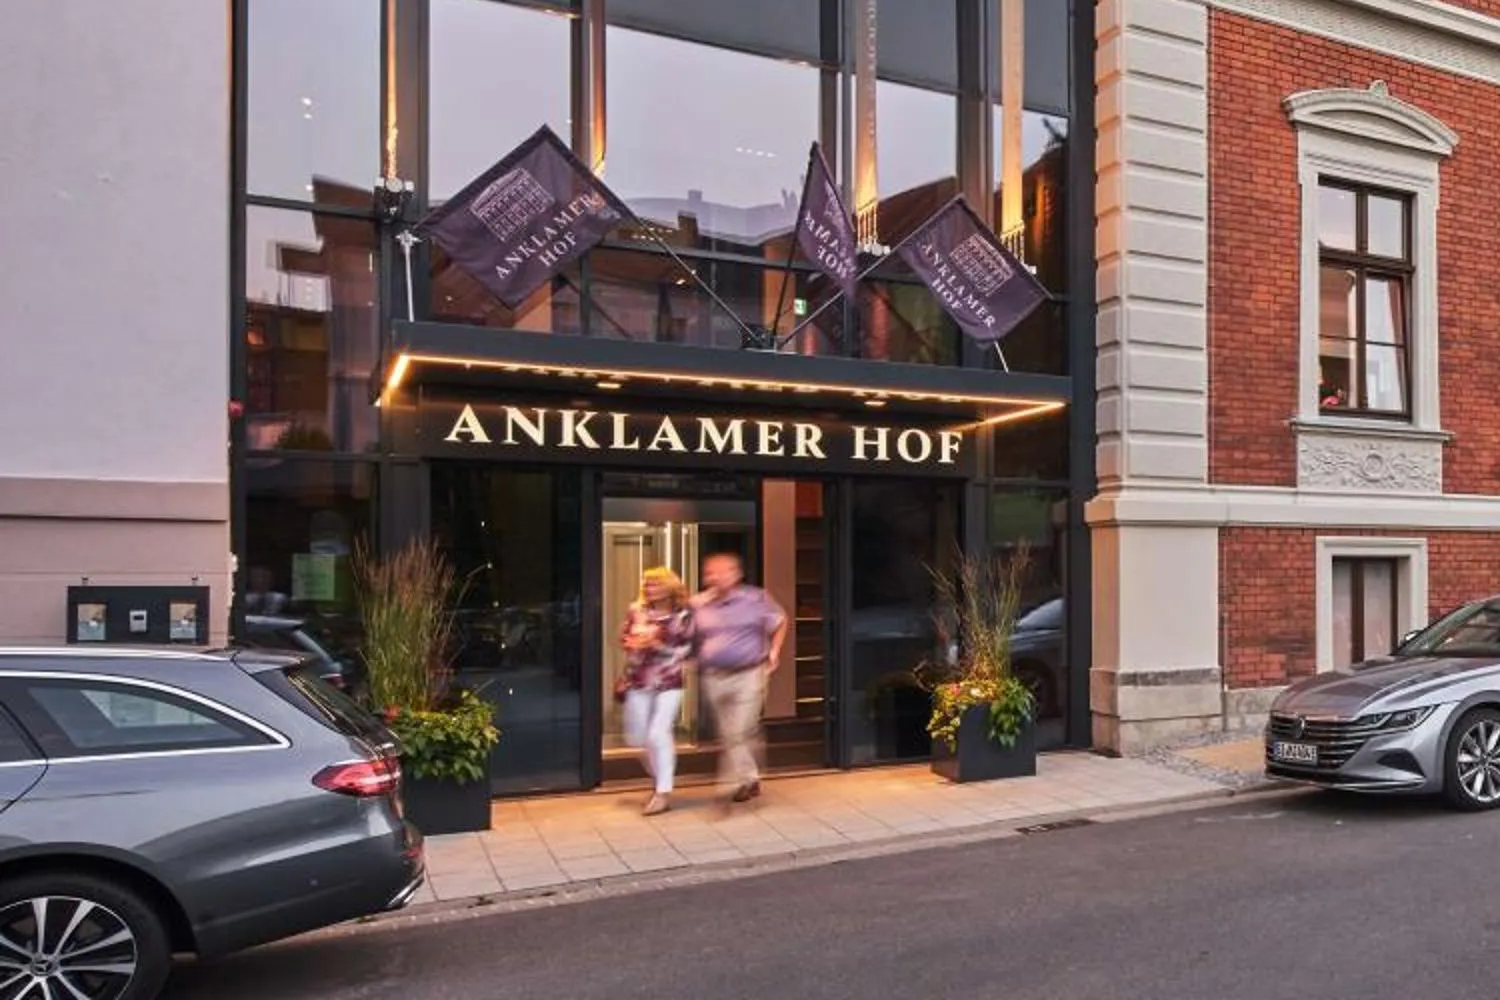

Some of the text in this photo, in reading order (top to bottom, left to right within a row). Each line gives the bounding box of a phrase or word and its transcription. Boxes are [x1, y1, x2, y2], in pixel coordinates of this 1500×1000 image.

[494, 190, 604, 280] ANKLAMER
[538, 230, 578, 267] HOF
[921, 242, 996, 328] ANKLAMER
[931, 278, 963, 309] HOF
[444, 402, 963, 464] ANKLAMER HOF
